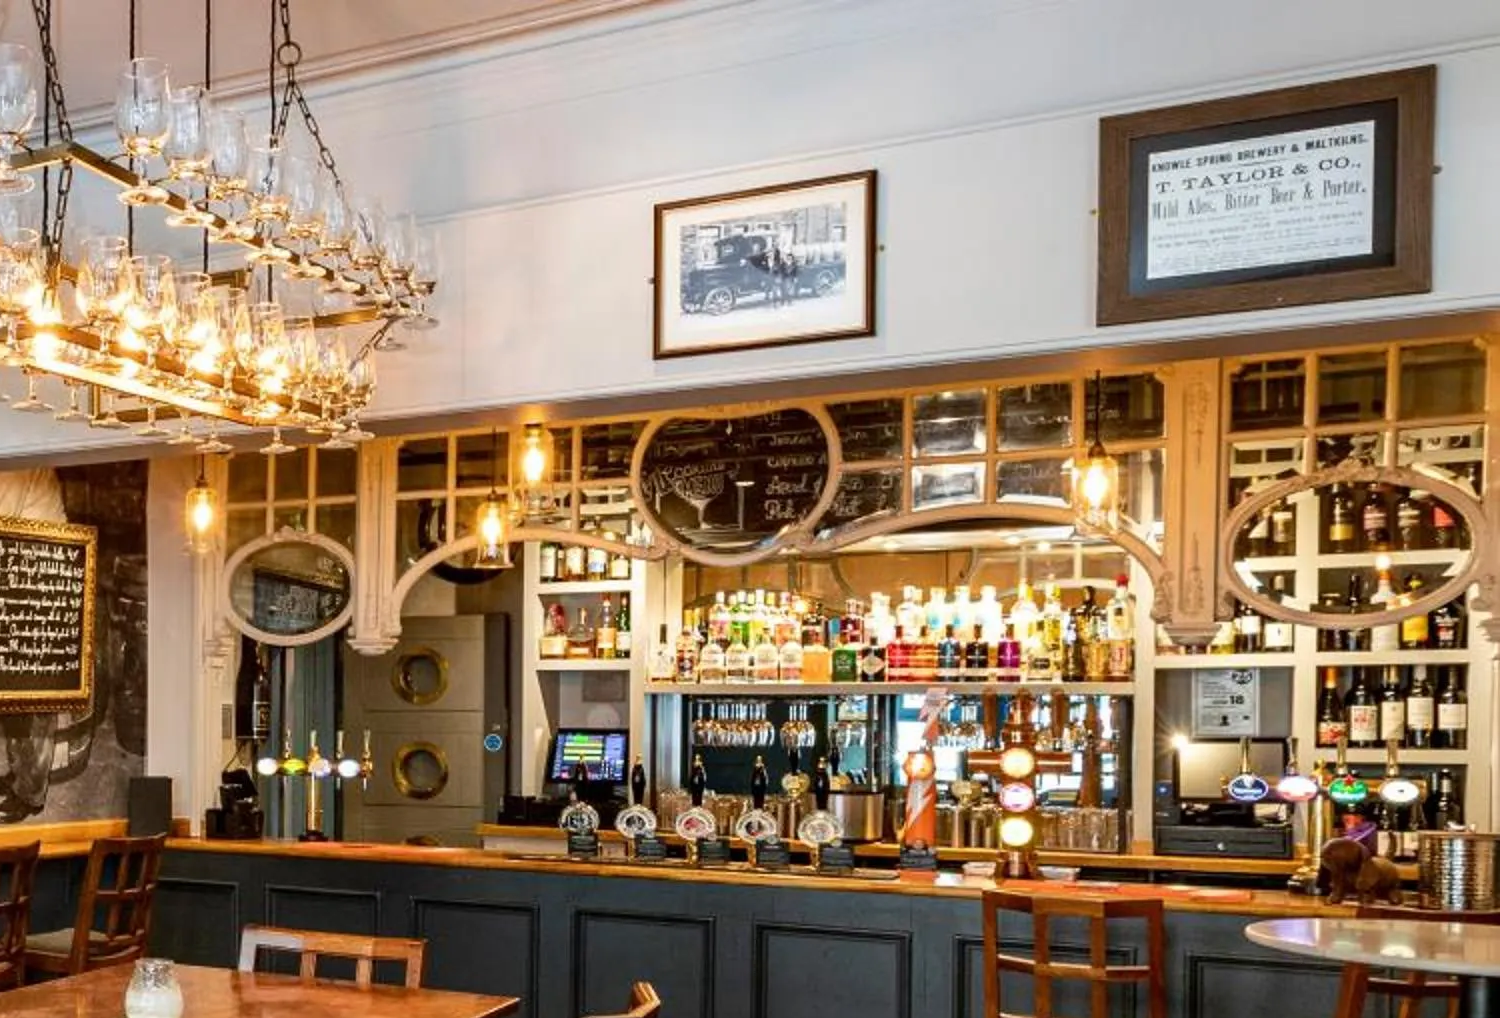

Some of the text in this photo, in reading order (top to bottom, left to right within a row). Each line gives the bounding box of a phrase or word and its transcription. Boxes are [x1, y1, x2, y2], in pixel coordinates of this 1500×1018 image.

[1151, 157, 1191, 172] KNOWLE
[1196, 152, 1232, 167] SPRING
[1237, 144, 1286, 161] BREWERY
[1290, 143, 1299, 153] &
[1155, 180, 1175, 194] T.
[1181, 165, 1284, 191] TAYLOR
[1291, 163, 1309, 176] &
[1151, 198, 1179, 220] Mild
[1225, 192, 1260, 211] Bitter
[1270, 187, 1296, 205] Beer
[1303, 181, 1314, 200] &
